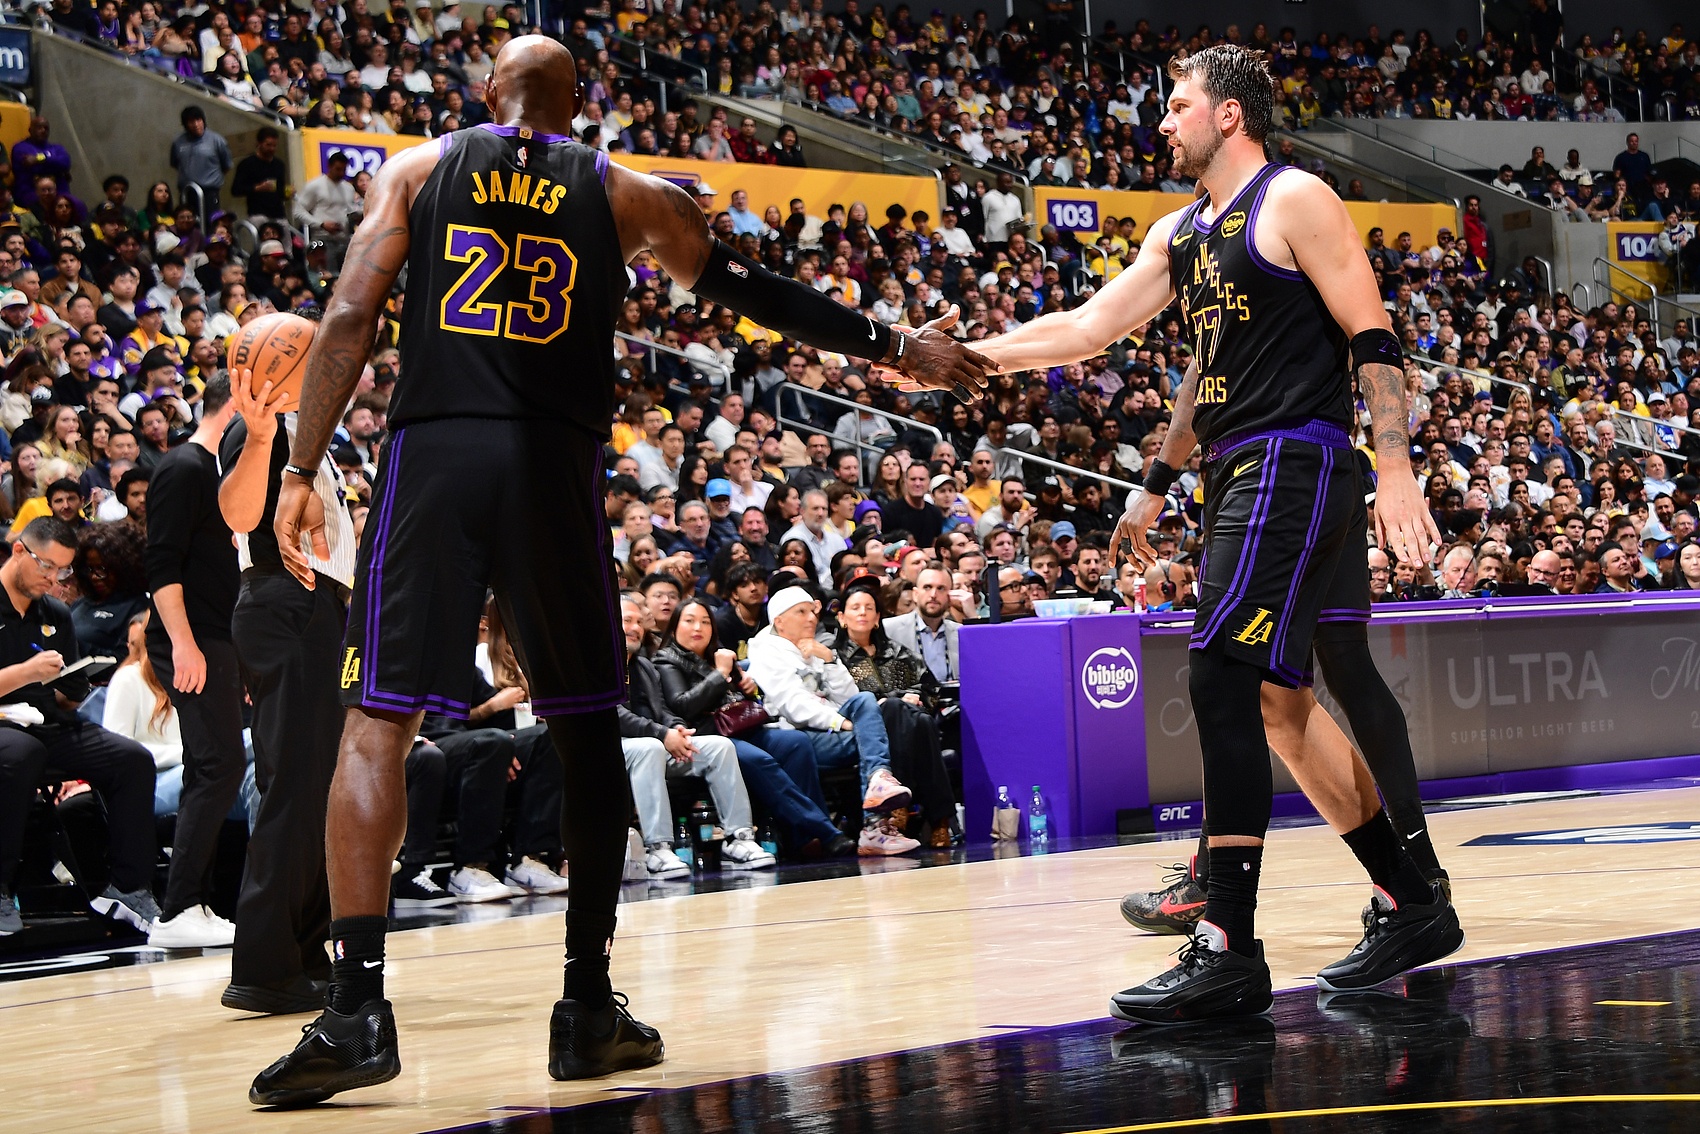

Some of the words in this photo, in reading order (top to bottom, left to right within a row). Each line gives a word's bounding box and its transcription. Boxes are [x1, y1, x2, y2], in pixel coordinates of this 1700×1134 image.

[472, 170, 567, 215] JAMES
[1051, 203, 1094, 228] 103
[1620, 236, 1661, 258] 104
[440, 223, 578, 344] 23
[1191, 304, 1222, 374] 77
[1232, 607, 1273, 645] LA
[341, 646, 361, 689] LA
[1087, 663, 1135, 691] bibigo
[1447, 650, 1609, 710] ULTRA
[1451, 726, 1523, 744] SUPERIOR
[1532, 722, 1573, 738] LIGHT
[1581, 719, 1615, 733] BEER
[1159, 805, 1192, 821] anc
